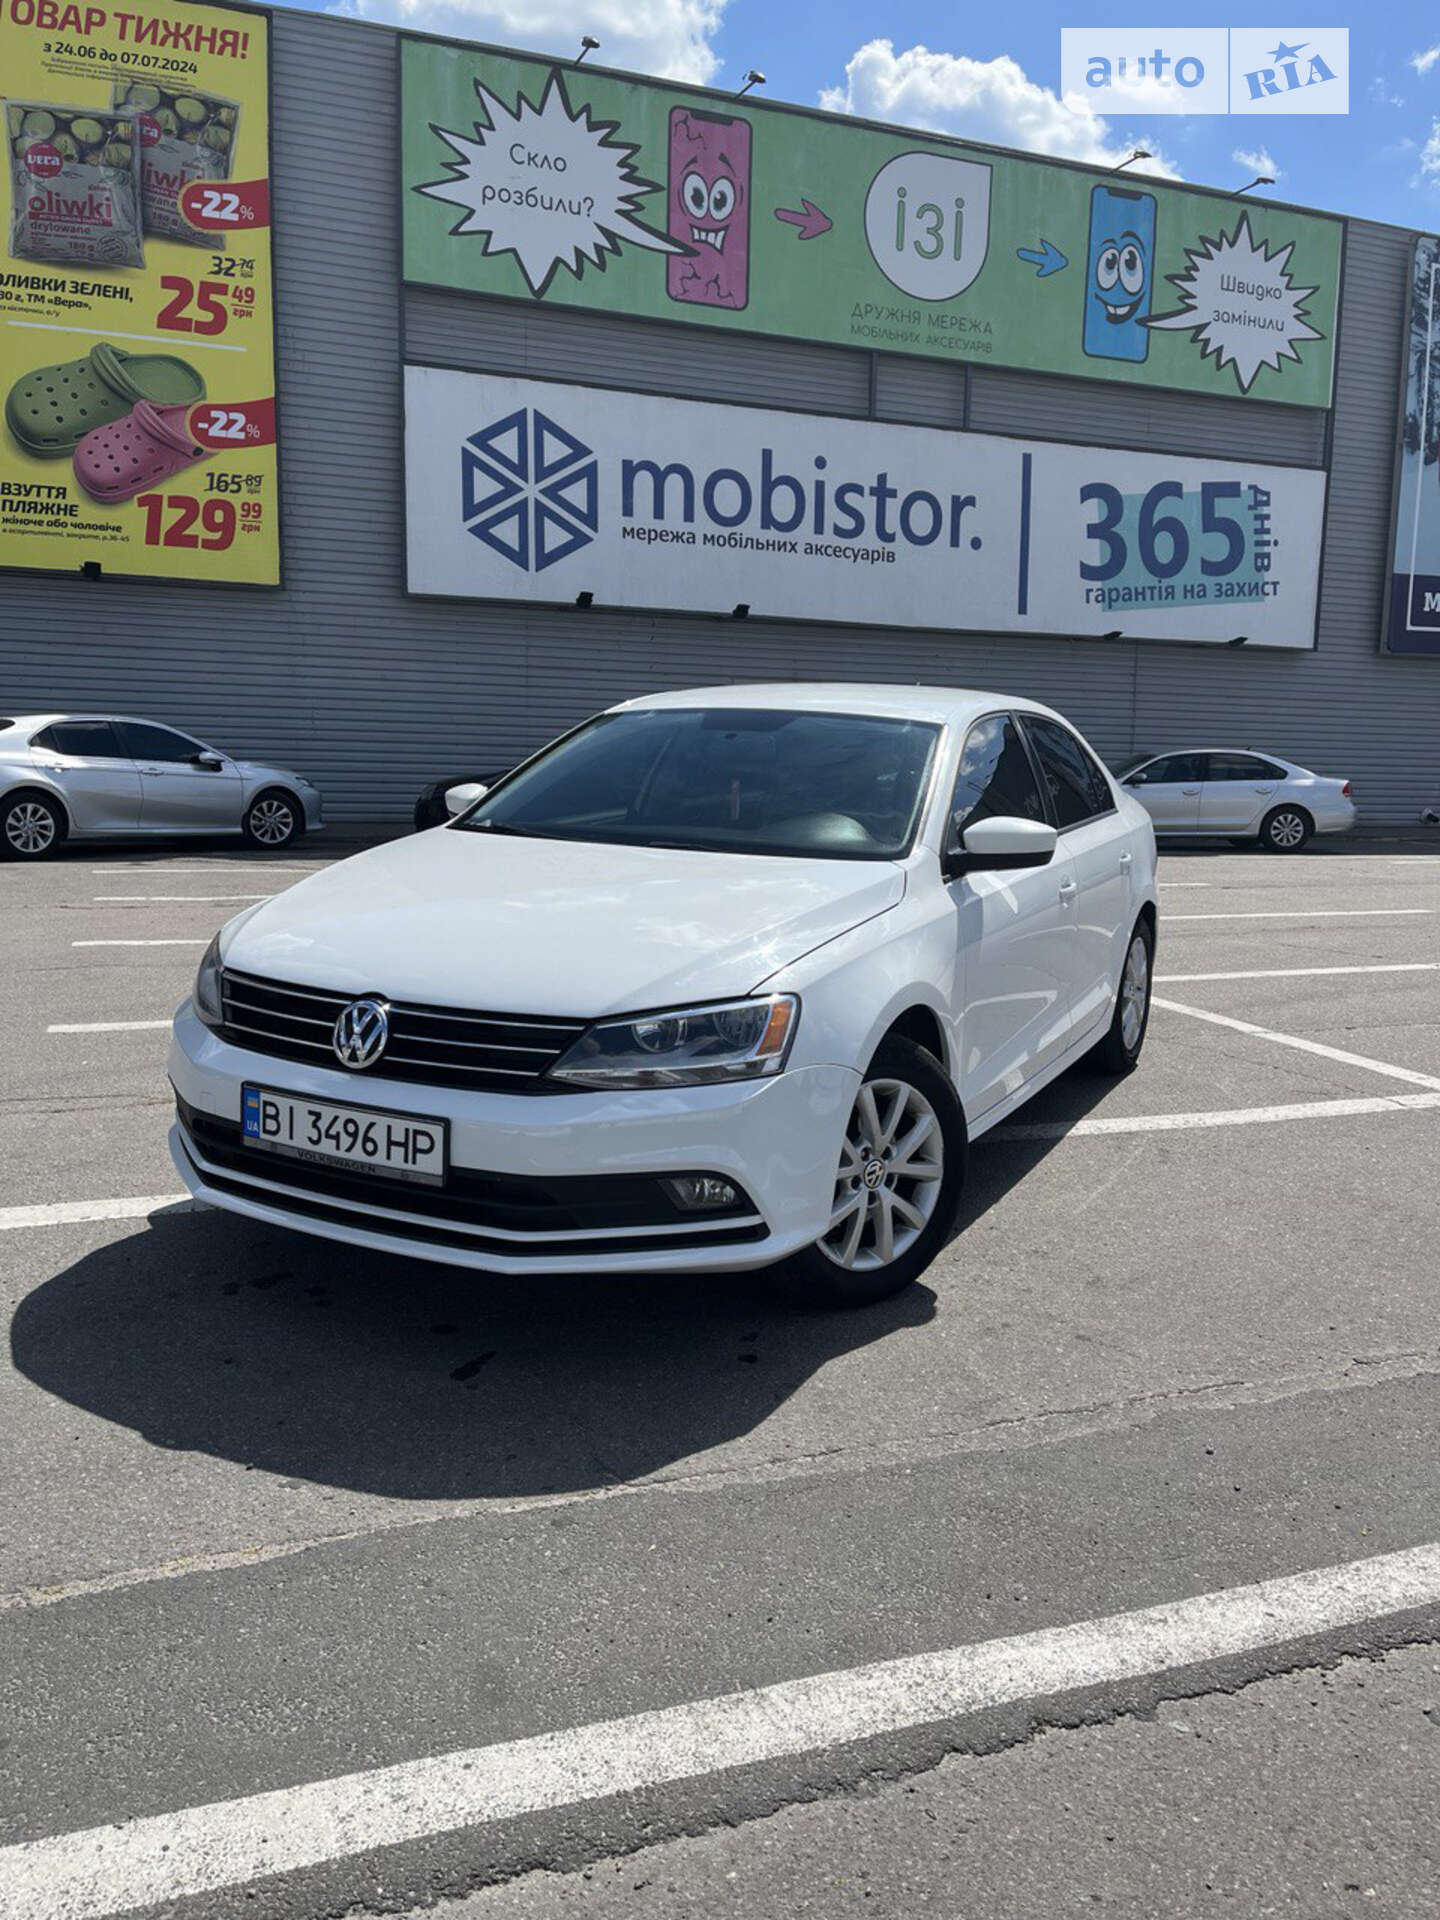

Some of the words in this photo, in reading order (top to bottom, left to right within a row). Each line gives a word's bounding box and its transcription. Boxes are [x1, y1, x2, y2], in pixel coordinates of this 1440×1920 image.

[0, 0, 106, 35] ОВАР
[113, 11, 249, 59] ТИЖНЯ!
[43, 43, 52, 53] з
[55, 42, 97, 59] 24.06
[99, 48, 118, 62] до
[120, 51, 198, 74] 07.07.2024
[509, 143, 567, 172] Скло
[28, 191, 112, 217] oliwki
[191, 191, 255, 221] -22%
[481, 184, 595, 217] розбили?
[210, 256, 235, 277] 32
[26, 293, 46, 304] ТМ
[69, 280, 133, 302] ЗЕЛЕНІ,
[1220, 273, 1283, 303] Швидко
[156, 275, 229, 336] 25
[231, 285, 255, 304] 49
[233, 308, 253, 319] грн
[850, 302, 922, 326] ДРУЖНЯ
[926, 312, 994, 336] МЕРЕЖА
[1211, 308, 1286, 333] замінили
[850, 324, 922, 346] МОБІЛЬНИХ
[925, 334, 993, 355] АКСЕСУАРІВ
[197, 410, 261, 440] -22%
[1, 482, 67, 499] ВЗУТТЯ
[204, 472, 242, 494] 165
[2, 499, 79, 517] ПЛЯЖНЕ
[621, 448, 982, 551] mobistor.
[2, 515, 44, 527] жіноче
[46, 518, 69, 529] або
[70, 521, 123, 534] чоловіче
[136, 494, 237, 551] 129
[240, 501, 262, 519] 99
[241, 523, 261, 534] грн
[1079, 480, 1246, 582] 365
[622, 525, 697, 546] мережа
[703, 532, 798, 554] мобільних
[803, 541, 896, 565] аксесуарів
[1085, 580, 1176, 609] гарантія
[1183, 584, 1208, 600] на
[1213, 580, 1281, 599] захист
[247, 1120, 259, 1131] UA
[262, 1100, 294, 1141] BI
[307, 1109, 379, 1157] 3496
[386, 1124, 435, 1165] HP
[296, 1149, 376, 1174] VOLKSWAGEN
